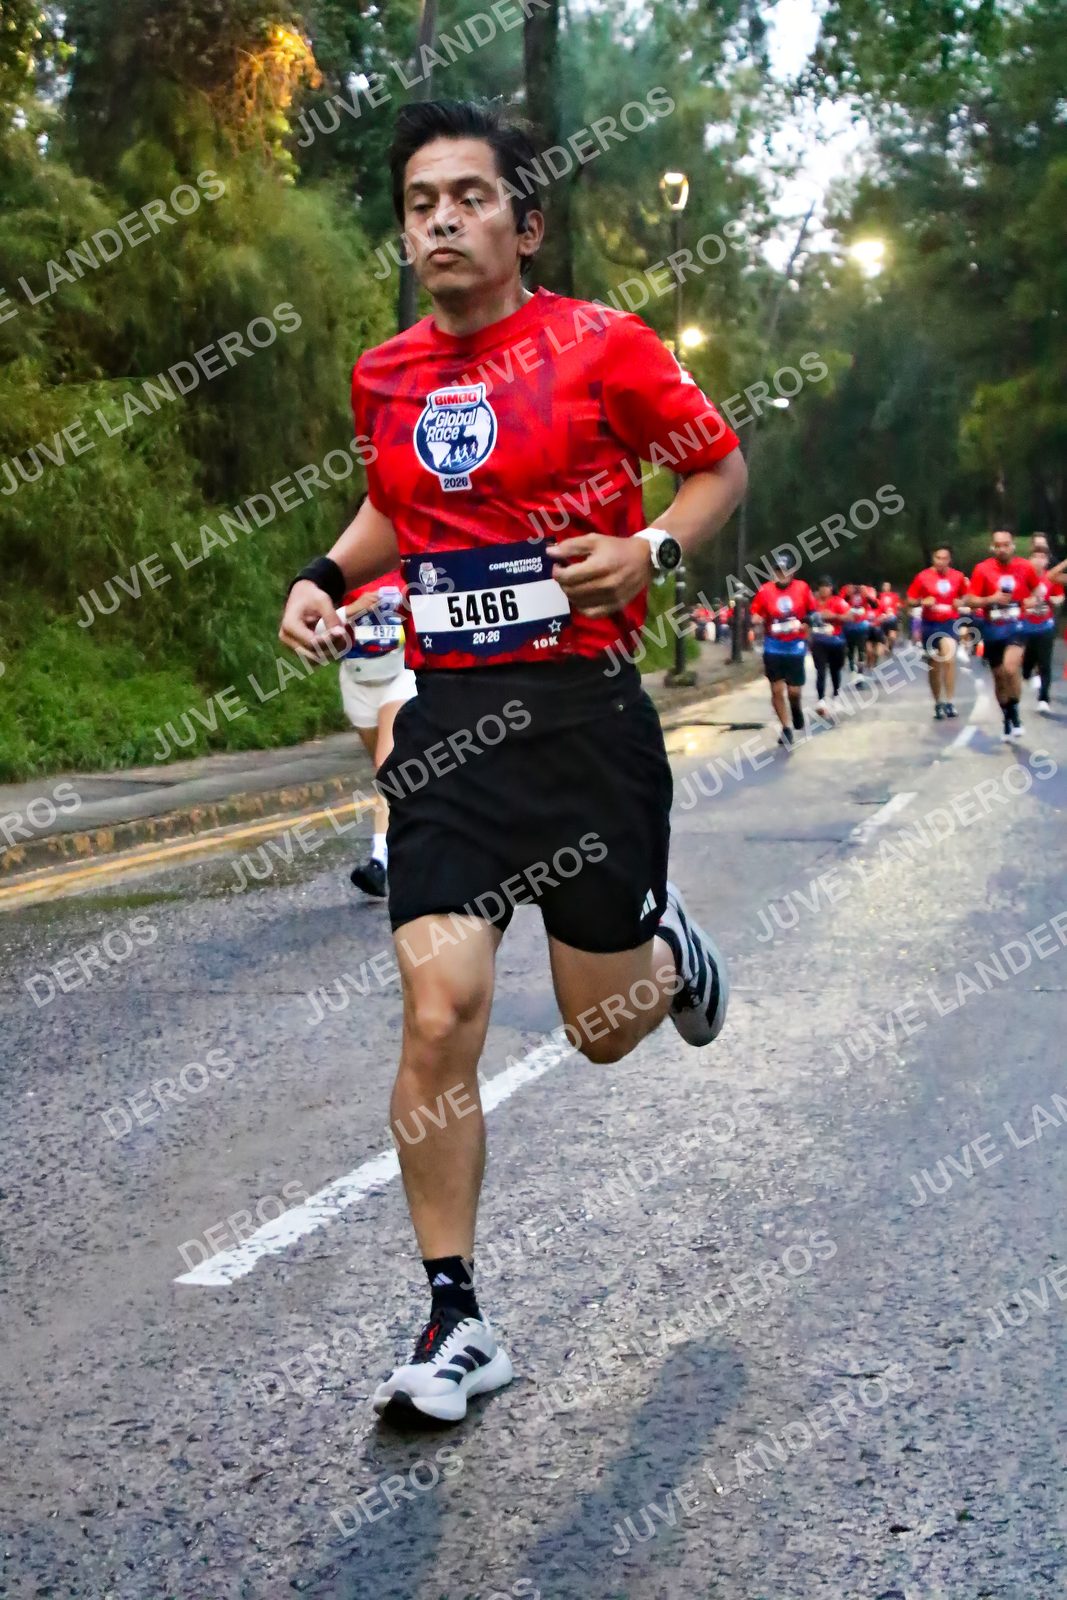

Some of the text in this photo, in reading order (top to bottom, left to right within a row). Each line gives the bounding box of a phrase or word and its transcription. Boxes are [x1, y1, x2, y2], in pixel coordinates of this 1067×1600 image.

[436, 408, 477, 427] Global
[426, 425, 460, 442] Race
[489, 556, 542, 572] COMPARTIMOS
[447, 588, 520, 628] 5466
[532, 636, 559, 650] 10K
